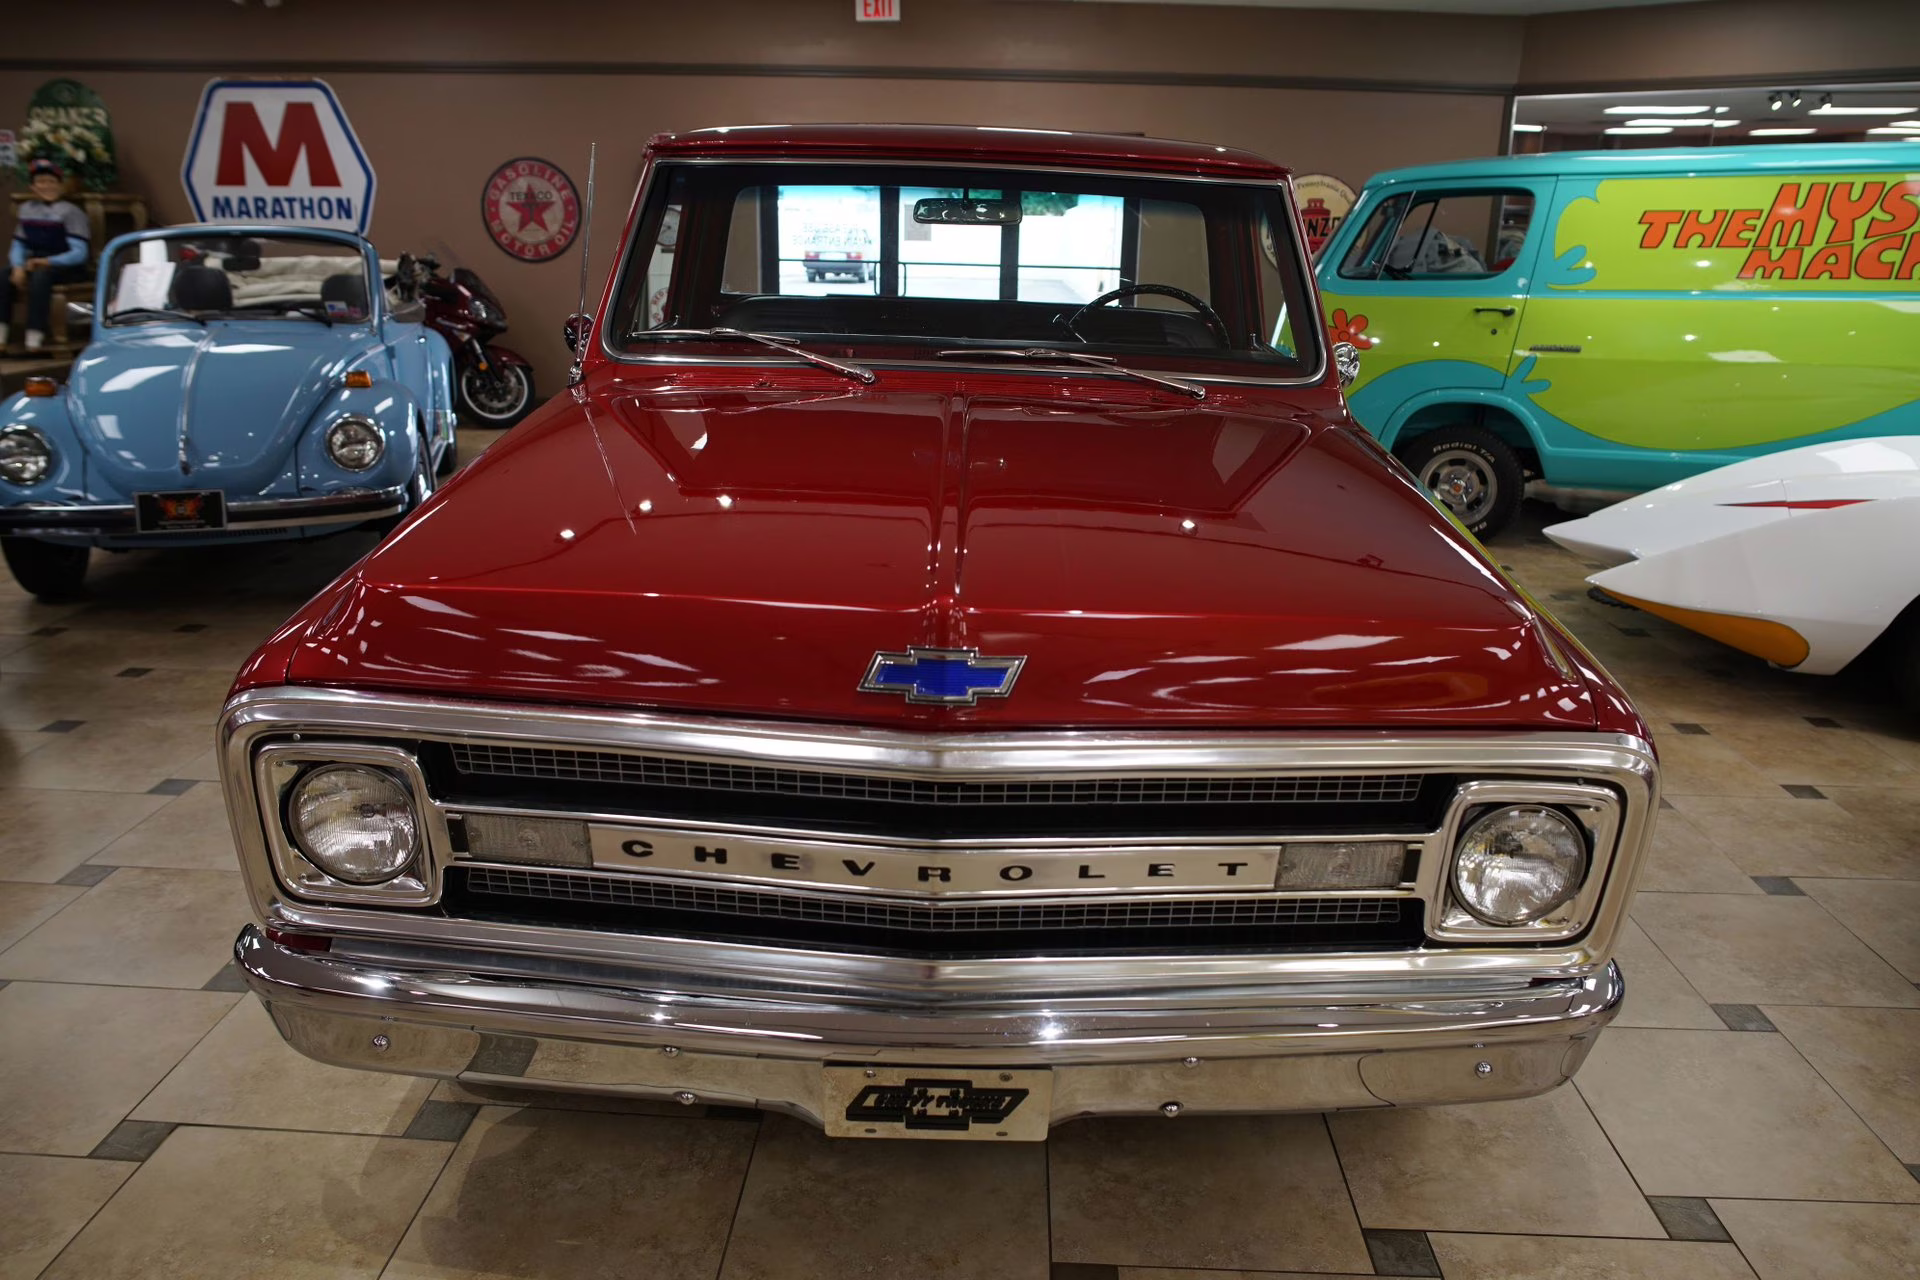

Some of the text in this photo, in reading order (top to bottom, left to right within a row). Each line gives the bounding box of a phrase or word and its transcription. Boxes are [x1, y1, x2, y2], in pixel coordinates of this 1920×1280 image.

[215, 102, 343, 187] M
[489, 163, 573, 201] GASOLINE
[212, 195, 353, 220] MARATHON
[1638, 181, 1920, 249] THE MYS
[491, 219, 576, 256] MOTOR OIL
[1433, 441, 1477, 454] Radial
[621, 839, 1248, 882] CHEVROLET
